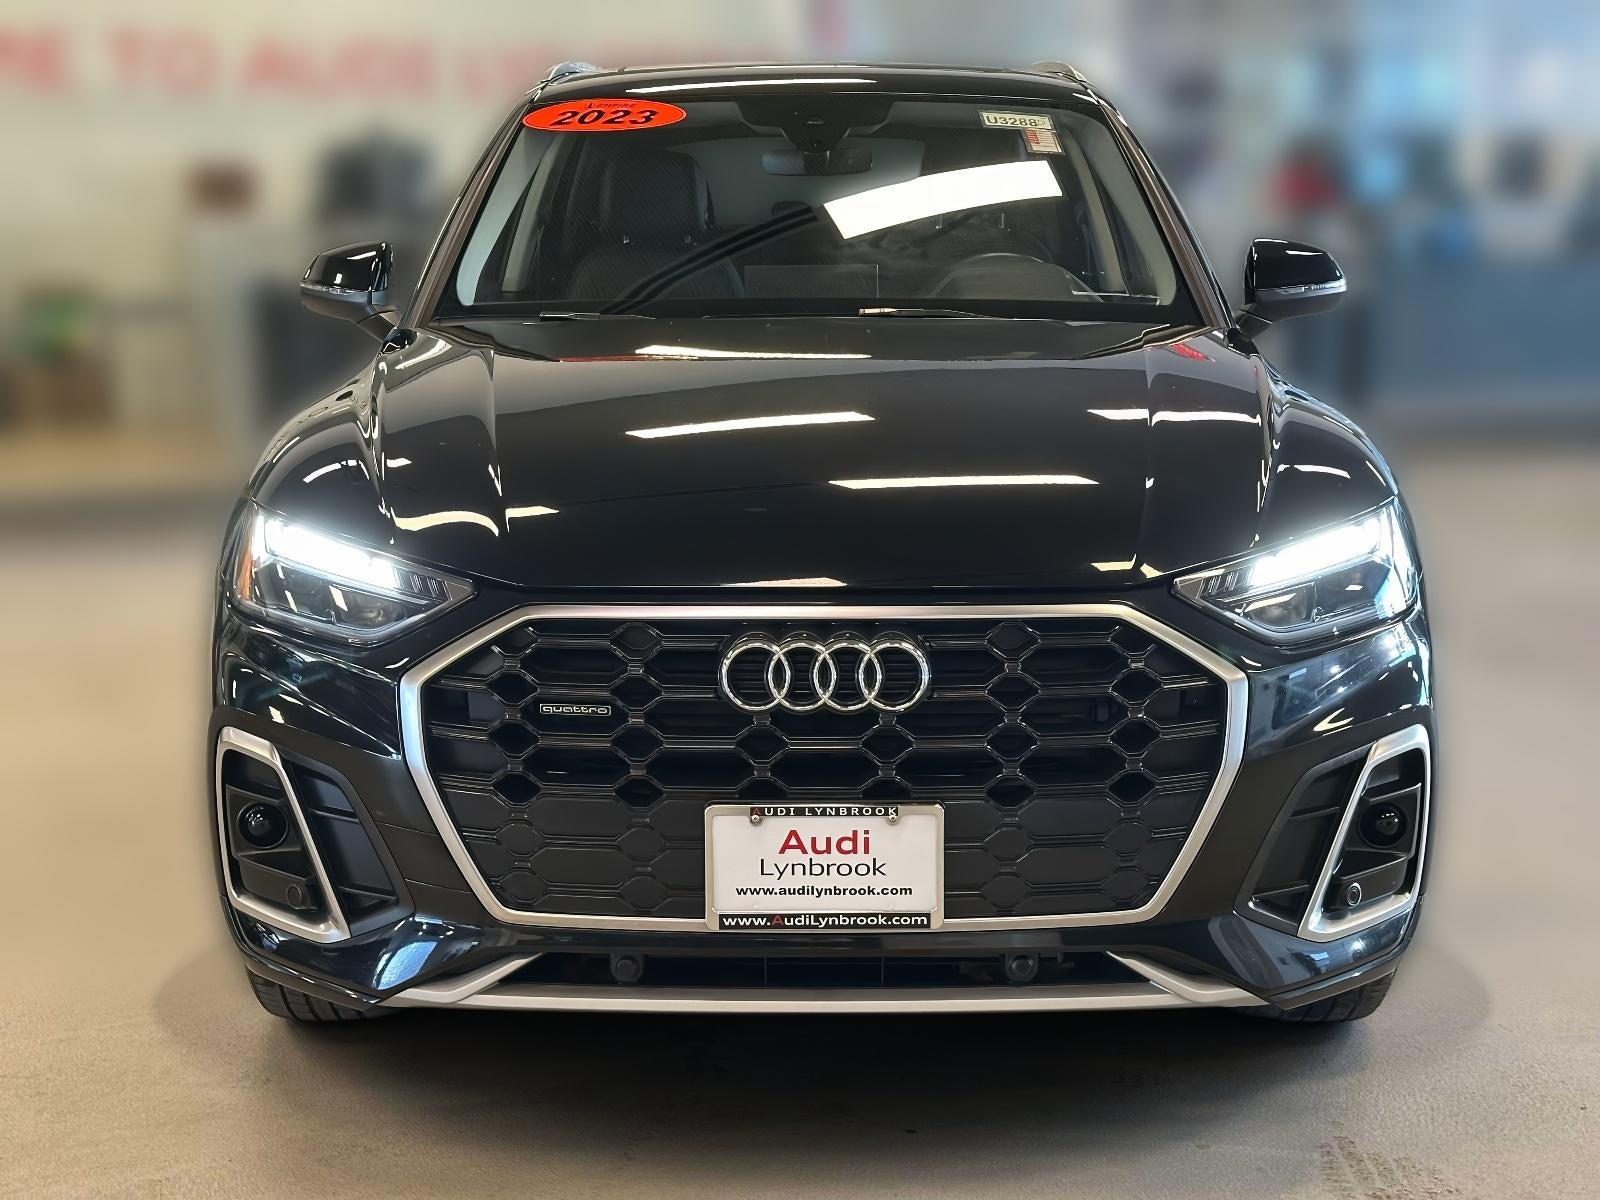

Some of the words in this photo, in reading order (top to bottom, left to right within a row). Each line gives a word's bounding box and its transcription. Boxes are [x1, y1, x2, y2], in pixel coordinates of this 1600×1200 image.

[550, 109, 659, 126] 2023
[542, 706, 608, 714] quattro
[752, 807, 795, 816] AUDI
[804, 807, 897, 816] LYNBROOK
[778, 829, 870, 855] Audi
[760, 857, 887, 880] Lynbrook
[736, 885, 913, 898] www.audilynbrook.com
[722, 914, 928, 928] www.AudiLynbrook.com
